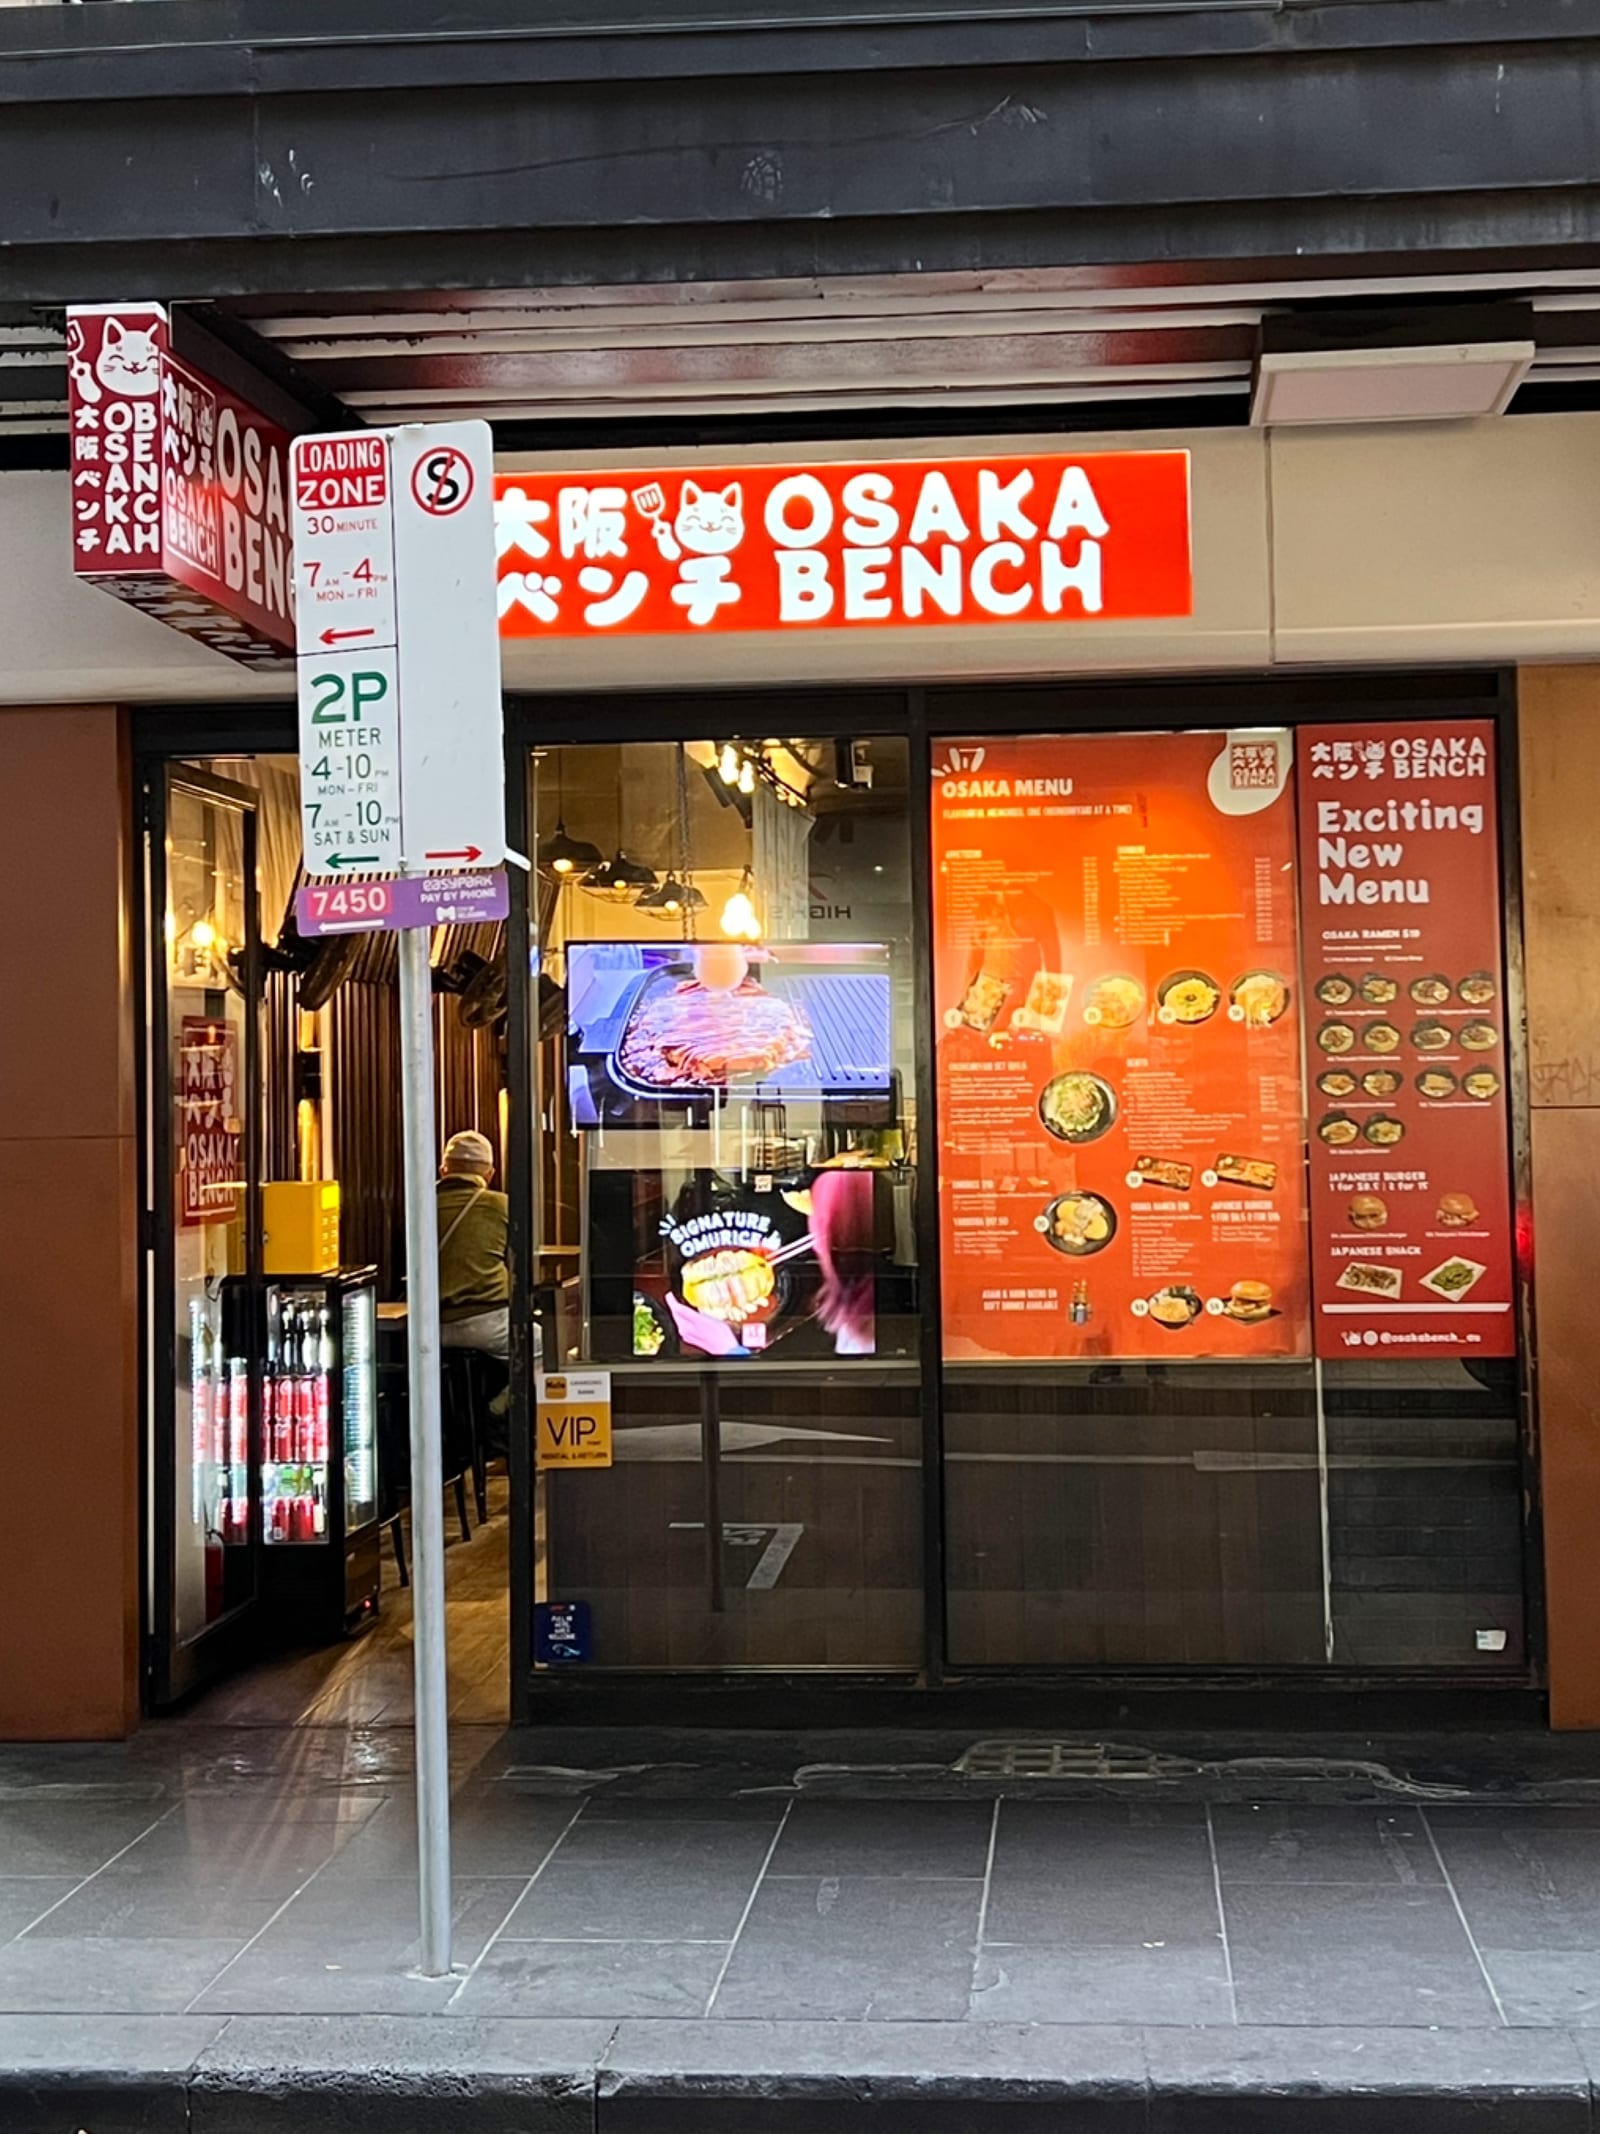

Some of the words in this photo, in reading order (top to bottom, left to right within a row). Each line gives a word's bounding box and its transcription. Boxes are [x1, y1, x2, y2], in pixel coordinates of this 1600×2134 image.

[300, 440, 380, 474] LOADING
[103, 401, 132, 554] OSAKA
[132, 402, 160, 554] BENCH
[298, 474, 385, 508] ZONE
[494, 487, 630, 560] 大阪
[763, 466, 1110, 549] OSAKA
[306, 516, 335, 535] 30
[336, 518, 379, 533] MINUTE
[496, 555, 742, 627] ベンチ
[773, 540, 1104, 623] BENCH
[310, 671, 388, 724] 2P
[318, 728, 381, 749] METER
[1310, 741, 1354, 762] 大阪
[1389, 736, 1487, 758] OSAKA
[1392, 756, 1486, 780] BENCH
[941, 779, 1011, 799] OSAKA
[1014, 777, 1073, 797] MENU
[1317, 797, 1484, 835] Exciting
[314, 831, 342, 847] SAT
[346, 830, 356, 845] &
[360, 828, 391, 844] SUN
[1317, 836, 1404, 870] New
[312, 886, 387, 917] 7450
[420, 891, 442, 904] PAY
[442, 890, 459, 902] BY
[459, 887, 497, 901] PHONE
[1318, 871, 1430, 905] Menu
[1328, 1171, 1381, 1183] JAPANESE
[1383, 1170, 1427, 1182] BURGER
[670, 1210, 772, 1246] SIGNATURE
[679, 1229, 763, 1258] OMURICE
[1330, 1246, 1383, 1258] JAPANESE
[545, 1415, 597, 1447] VIP
